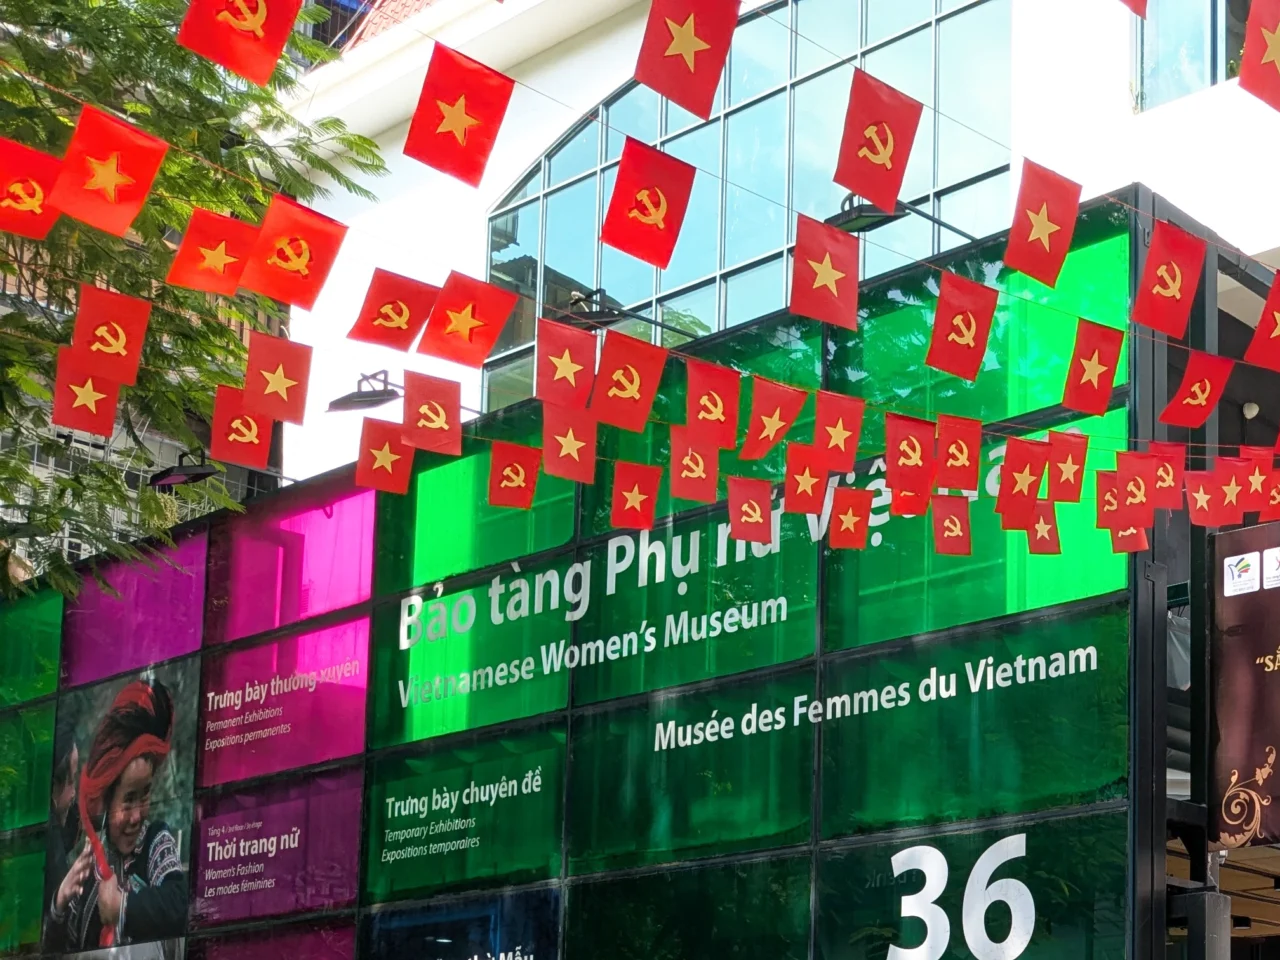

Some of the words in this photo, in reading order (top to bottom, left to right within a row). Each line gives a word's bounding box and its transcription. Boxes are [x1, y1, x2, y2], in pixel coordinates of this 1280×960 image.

[399, 581, 477, 650] Bảo
[488, 560, 591, 625] tàng
[605, 529, 700, 596] Phụ
[398, 656, 535, 708] Vietnamese
[541, 620, 657, 675] Women’s
[664, 595, 788, 648] Museum
[207, 690, 242, 711] Trưng
[245, 680, 268, 704] bày
[271, 669, 316, 692] thường
[319, 657, 360, 685] xuyên
[653, 709, 734, 752] Musée
[740, 702, 786, 737] des
[793, 682, 911, 727] Femmes
[917, 667, 957, 702] du
[964, 644, 1098, 693] Vietnam
[205, 733, 243, 751] Expositions
[243, 722, 291, 745] permanentes
[206, 715, 243, 732] Permanent
[244, 706, 283, 723] Exhibitions
[386, 796, 428, 818] Trưng
[432, 786, 459, 813] bày
[462, 776, 517, 806] chuyên
[522, 766, 542, 794] đề
[207, 837, 236, 862] Thời
[240, 836, 277, 857] trang
[280, 827, 300, 850] nữ
[385, 825, 428, 843] Temporary
[429, 817, 476, 835] Exhibitions
[382, 845, 427, 864] Expositions
[429, 836, 480, 856] temporaires
[205, 867, 235, 880] Women’s
[236, 862, 264, 876] Fashion
